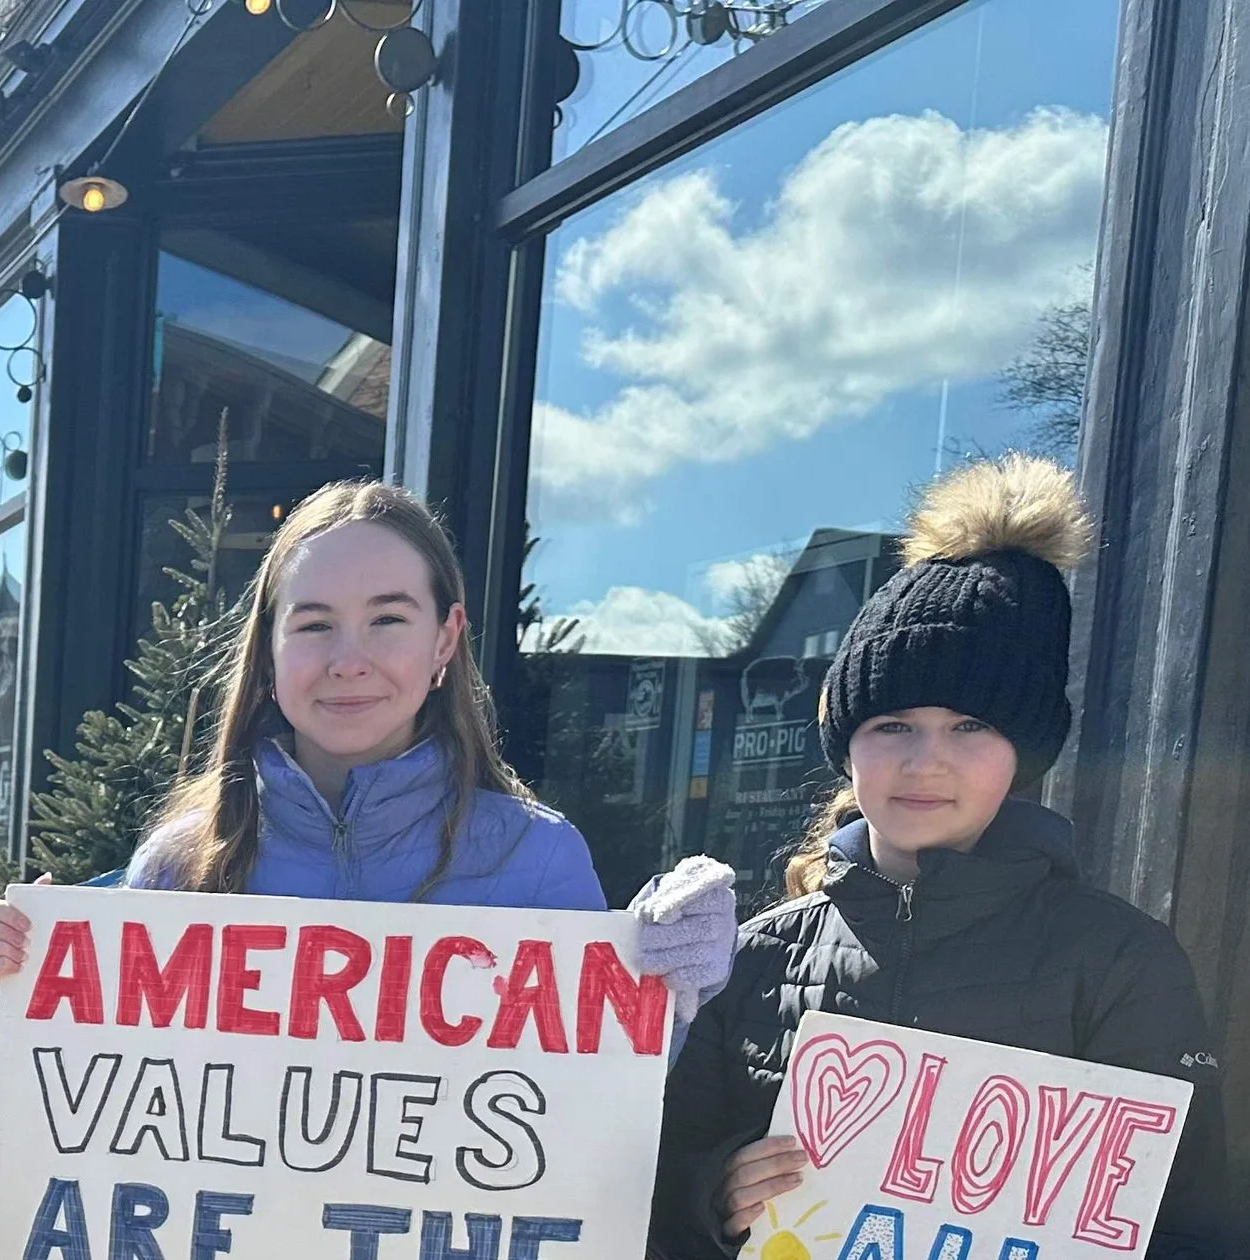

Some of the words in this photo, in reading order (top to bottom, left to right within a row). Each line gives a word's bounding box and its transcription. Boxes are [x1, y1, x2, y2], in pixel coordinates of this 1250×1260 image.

[25, 920, 669, 1055] AMERICAN
[33, 1047, 546, 1191] VALUES
[880, 1053, 1177, 1250] LOVE
